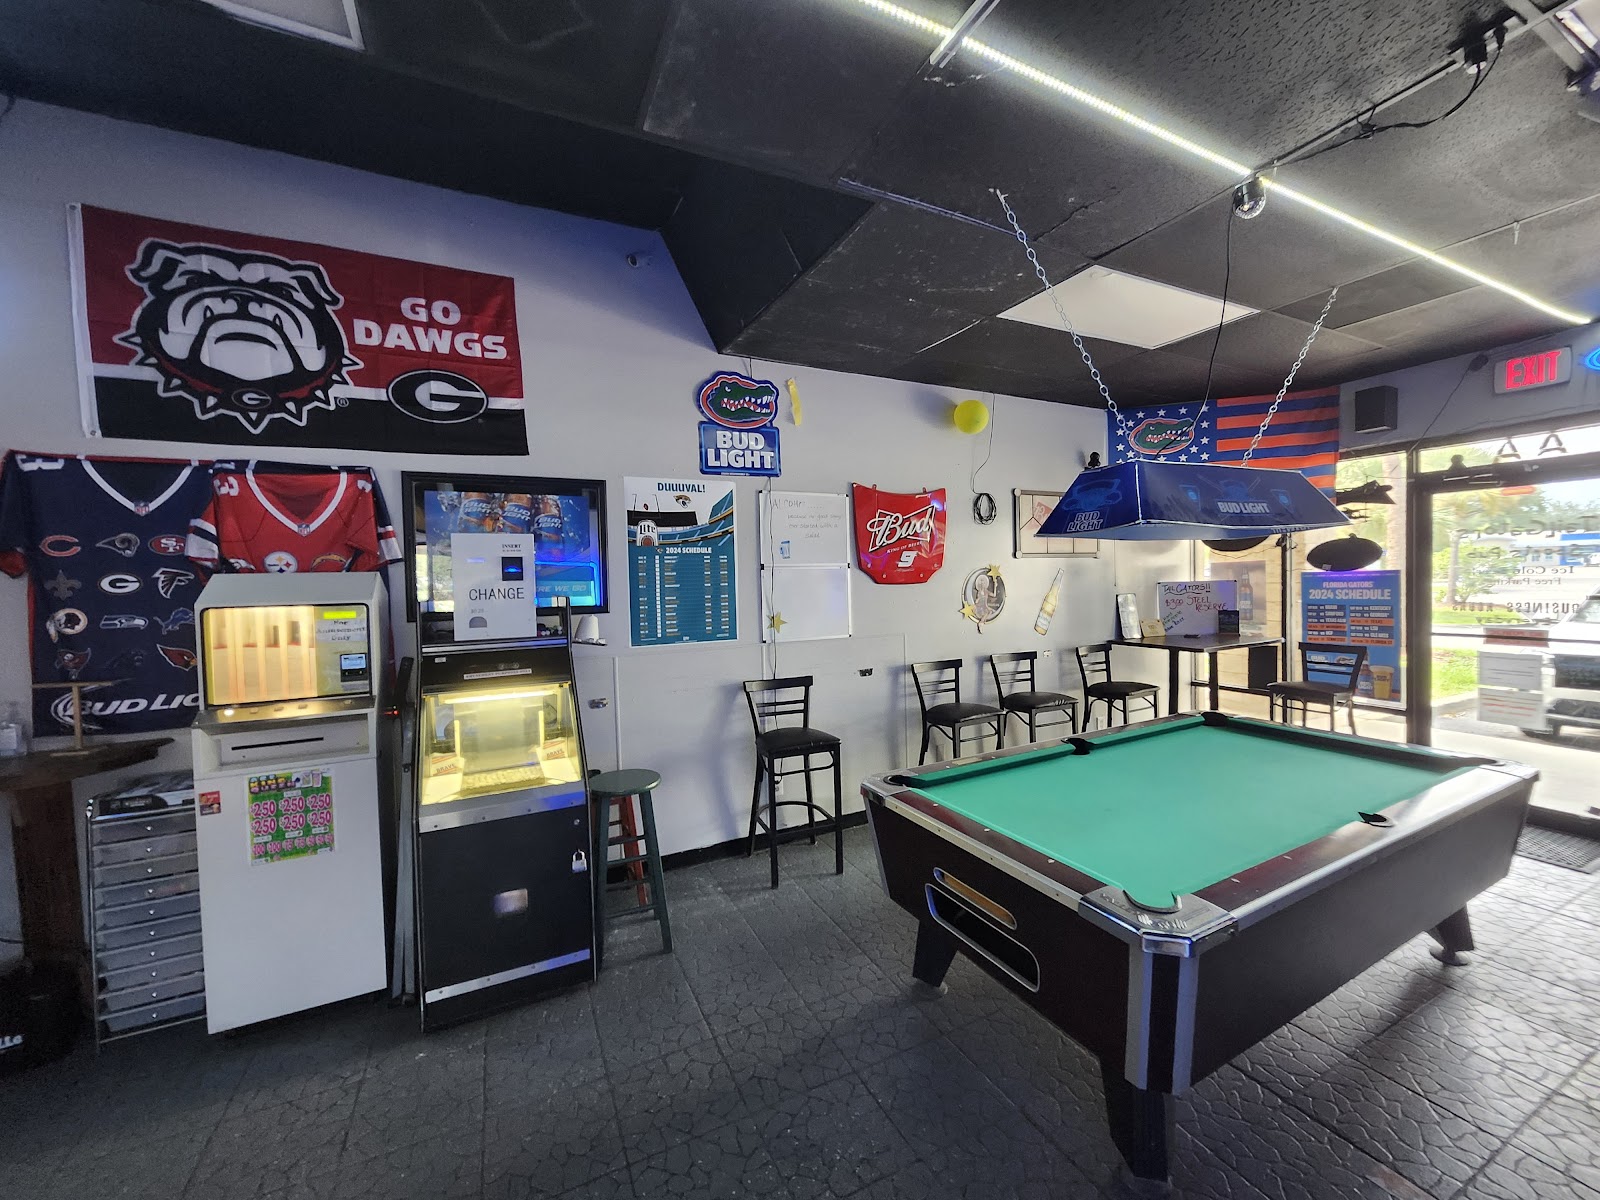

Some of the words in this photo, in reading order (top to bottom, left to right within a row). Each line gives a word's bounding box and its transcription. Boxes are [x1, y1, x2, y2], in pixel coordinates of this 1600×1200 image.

[400, 297, 461, 326] GO
[353, 318, 508, 360] DAWGS
[1505, 350, 1561, 390] EXIT
[716, 430, 765, 450] BUD
[707, 448, 774, 469] LIGHT
[657, 482, 707, 493] DUUUVAL!
[1217, 502, 1241, 513] BUD
[1240, 502, 1270, 514] LIGHT
[1074, 511, 1100, 522] BUD
[639, 524, 656, 535] Lite
[866, 507, 933, 547] Bud
[1066, 519, 1104, 532] LIGHT
[897, 551, 919, 567] 9
[468, 587, 525, 601] CHANGE
[1308, 589, 1334, 599] 2024
[1335, 589, 1392, 599] SCHEDULE
